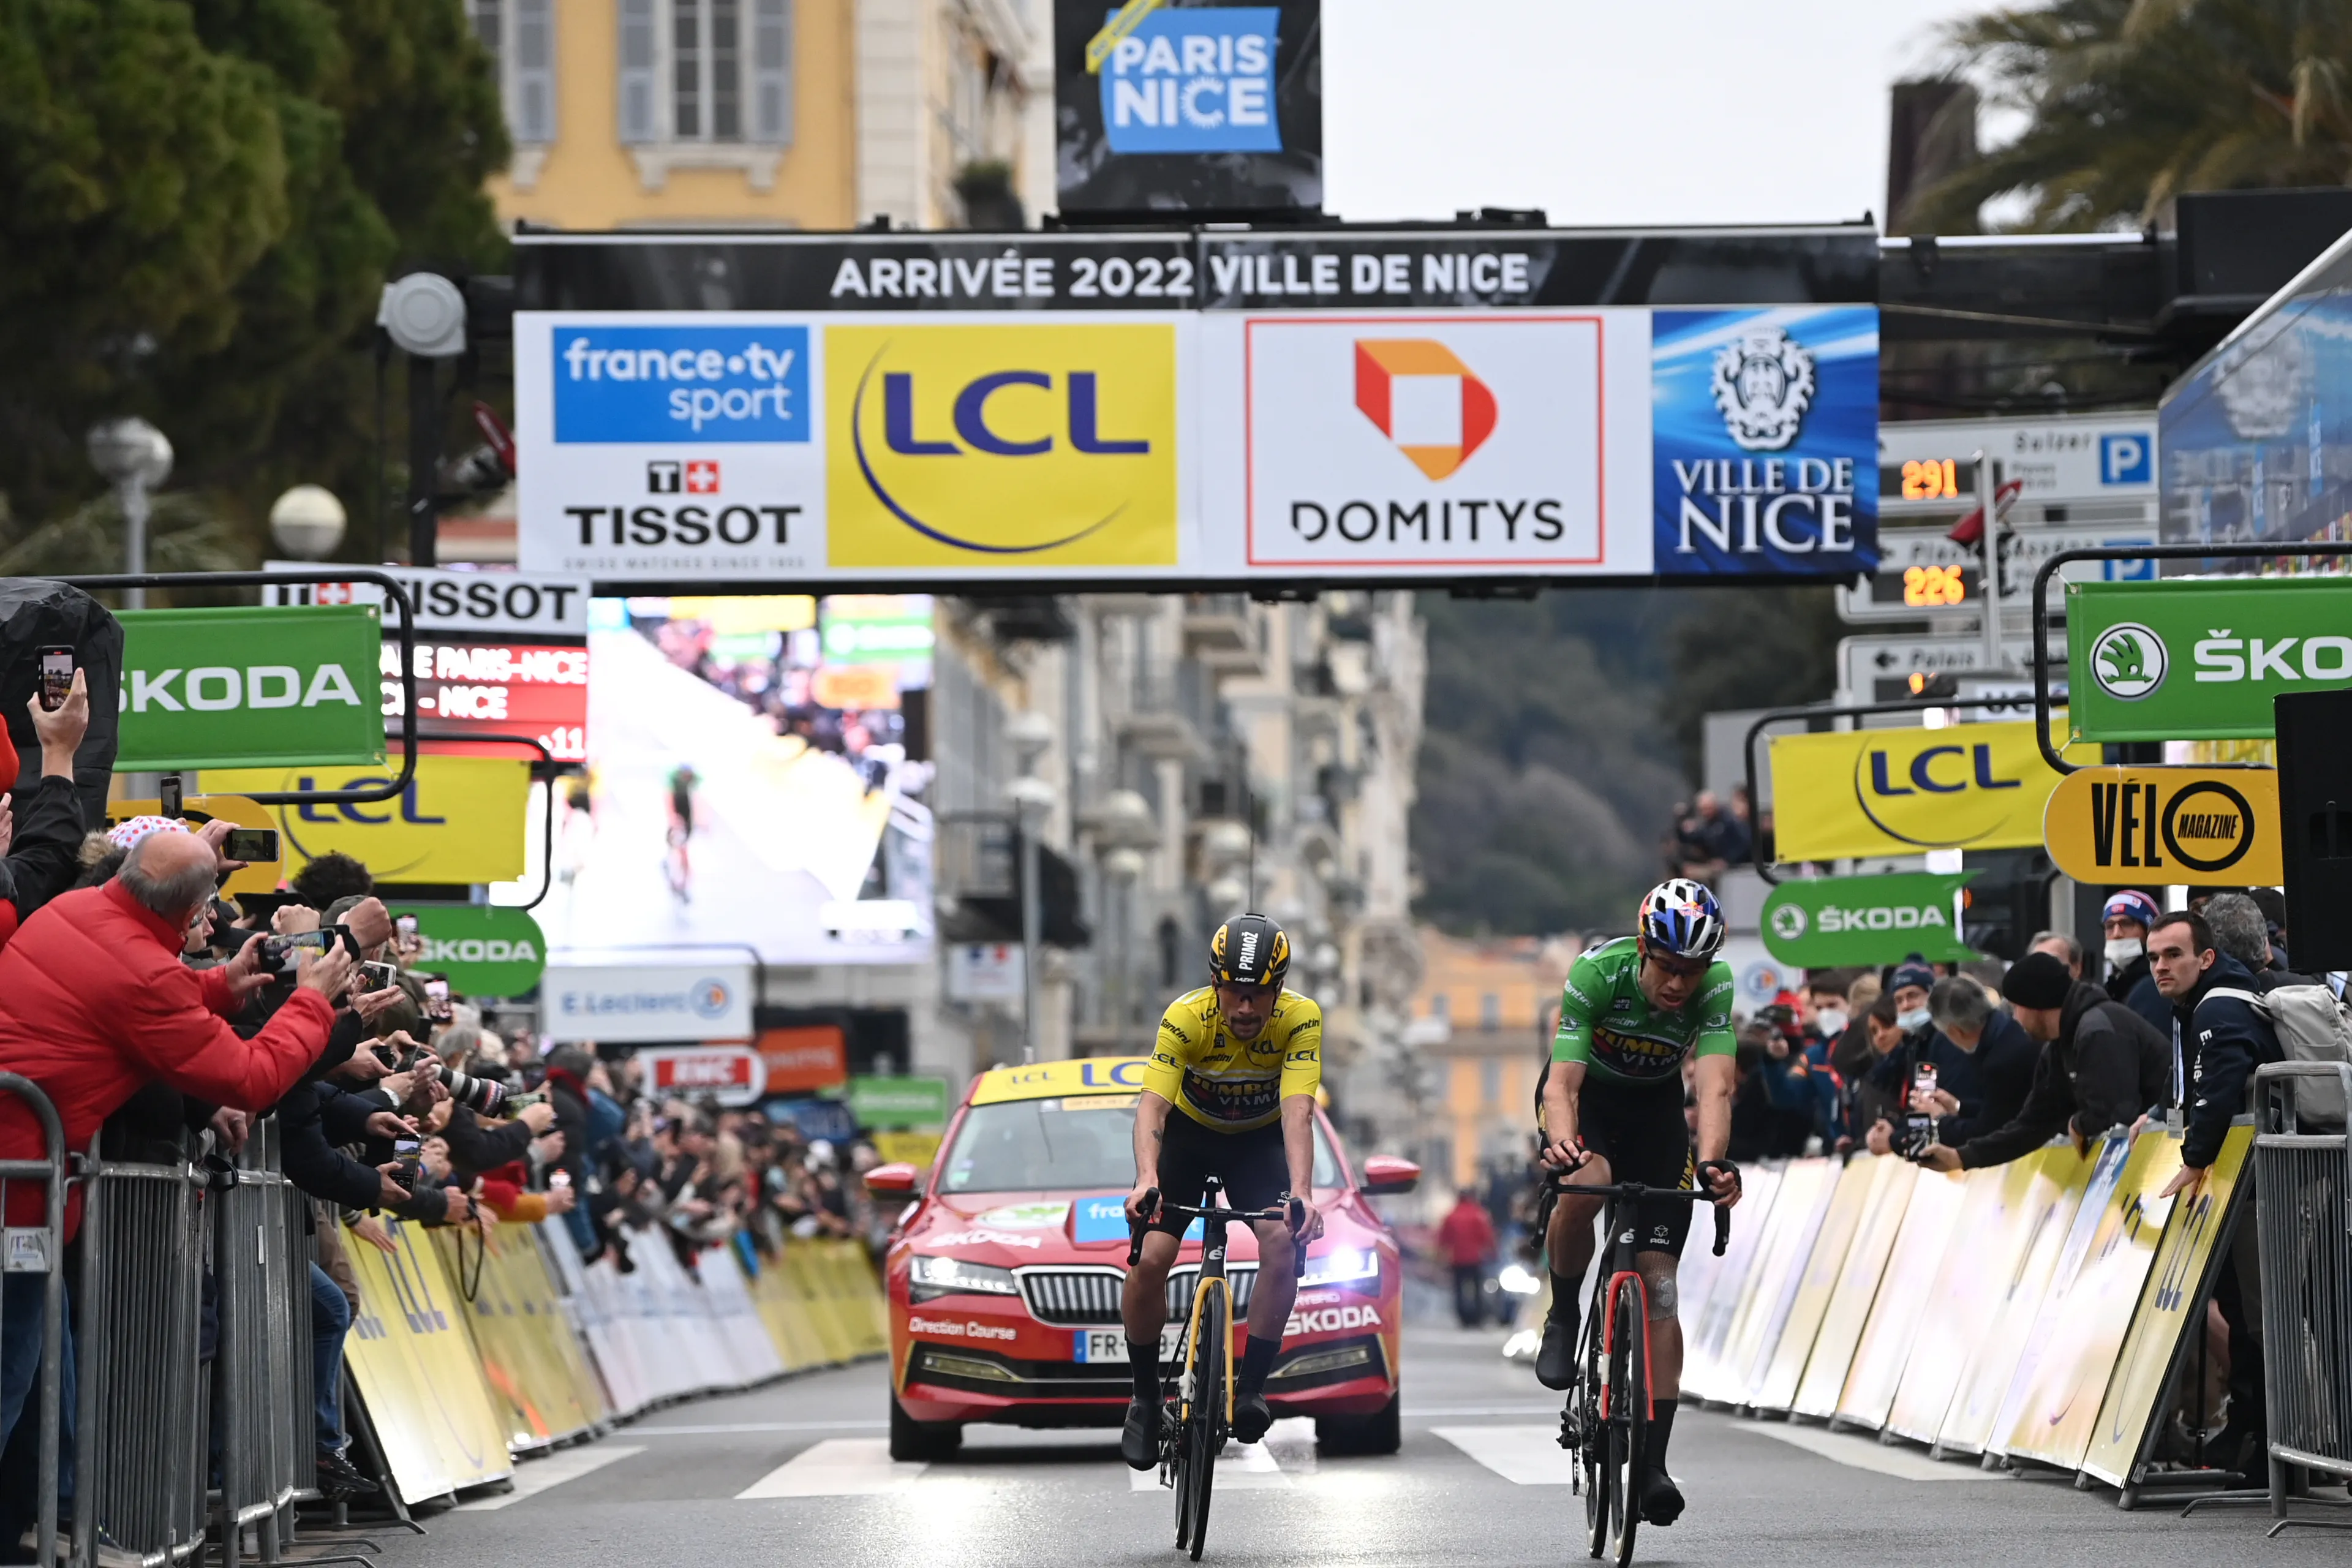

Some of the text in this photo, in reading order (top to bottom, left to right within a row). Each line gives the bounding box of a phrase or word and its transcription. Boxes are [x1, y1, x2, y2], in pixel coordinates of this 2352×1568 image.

[1114, 34, 1267, 75] PARIS
[1114, 77, 1267, 128] NICE
[830, 248, 1529, 297] ARRIVÉE 2022 VILLE DE NICE
[668, 382, 793, 432] sport
[883, 369, 1150, 456] LCL
[1670, 457, 1855, 495] VILLE DE
[1901, 458, 1959, 500] 291
[2108, 437, 2142, 481] P
[564, 506, 802, 545] TISSOT
[1290, 499, 1564, 542] DOMITYS
[1675, 494, 1855, 553] NICE
[1903, 564, 1965, 607] 226
[119, 663, 361, 713] KODA
[438, 685, 508, 720] NICE
[1870, 743, 2022, 797] LCL
[298, 776, 446, 825] LCL
[2177, 813, 2239, 840] MAGAZINE
[1817, 904, 1947, 933] ŠKODA
[1238, 931, 1259, 971] PRIMOŽ
[1152, 1051, 1180, 1069] LCL
[1251, 1039, 1283, 1055] LCL
[1286, 1050, 1319, 1063] LCL
[1011, 1071, 1055, 1085] LCL
[909, 1316, 1017, 1341] Direction Course
